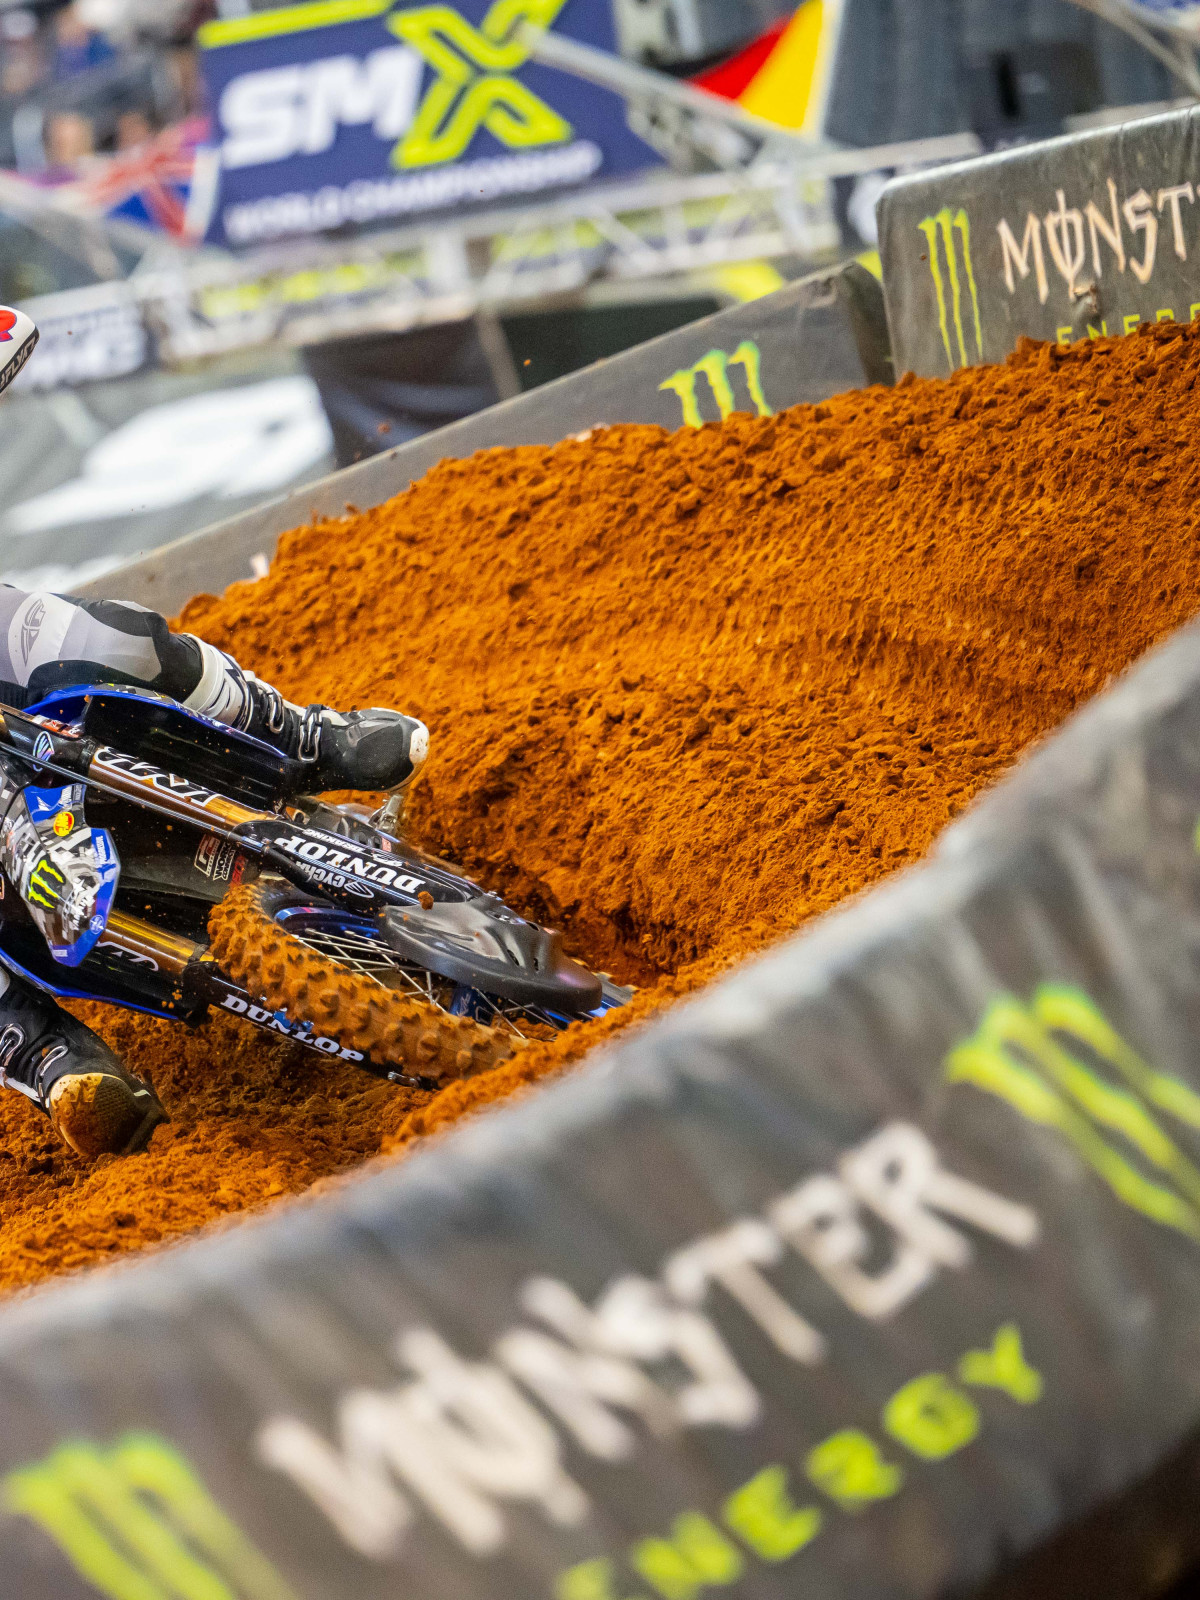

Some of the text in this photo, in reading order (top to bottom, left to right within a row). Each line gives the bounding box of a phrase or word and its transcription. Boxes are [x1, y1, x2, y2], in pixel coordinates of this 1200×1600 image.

[218, 0, 572, 171] SMX
[997, 177, 1200, 305] MONST
[274, 835, 426, 894] DUNLOP
[255, 1119, 1040, 1562] MONSTER
